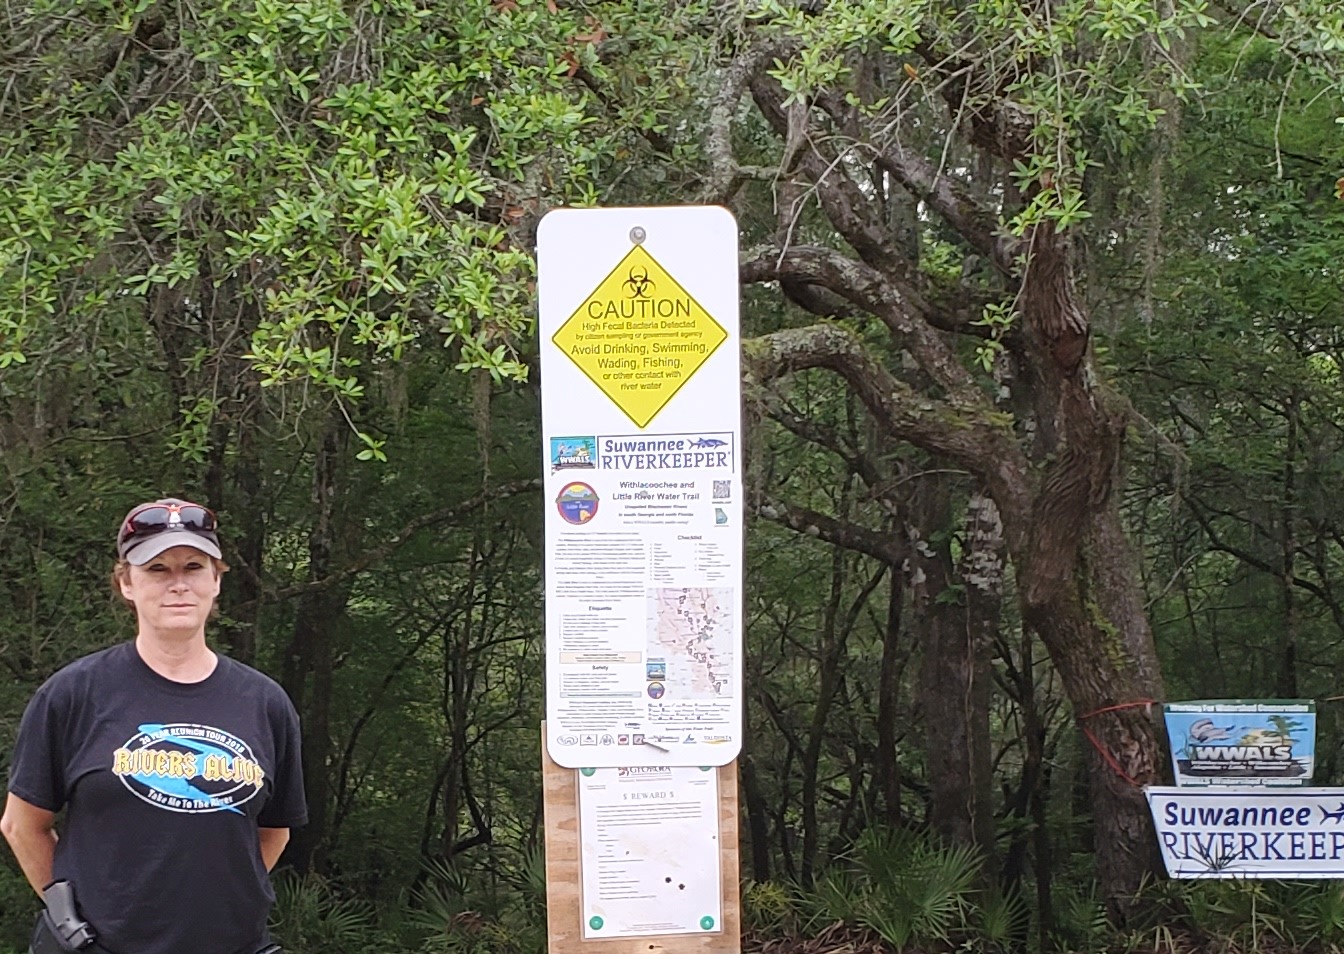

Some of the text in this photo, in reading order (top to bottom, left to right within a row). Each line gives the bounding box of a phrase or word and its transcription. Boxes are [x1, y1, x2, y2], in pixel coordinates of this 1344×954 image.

[588, 299, 691, 319] CAUTION
[582, 320, 696, 332] High Fecal Bacteria Detected
[571, 342, 709, 355] Avoid Drinking, Swimming,
[598, 357, 683, 370] Wading, Fishing,
[635, 371, 664, 379] contact
[666, 370, 681, 378] with
[640, 382, 662, 390] water
[605, 439, 685, 453] Suwannee
[682, 492, 700, 500] Trail
[171, 728, 204, 737] REUNION
[206, 730, 227, 741] TOUR
[1197, 746, 1291, 760] WWALS
[112, 747, 265, 788] RIVERS ALIVE
[148, 788, 234, 808] Take Me To The River
[631, 792, 666, 800] REWARD
[1164, 801, 1311, 827] Suwannee
